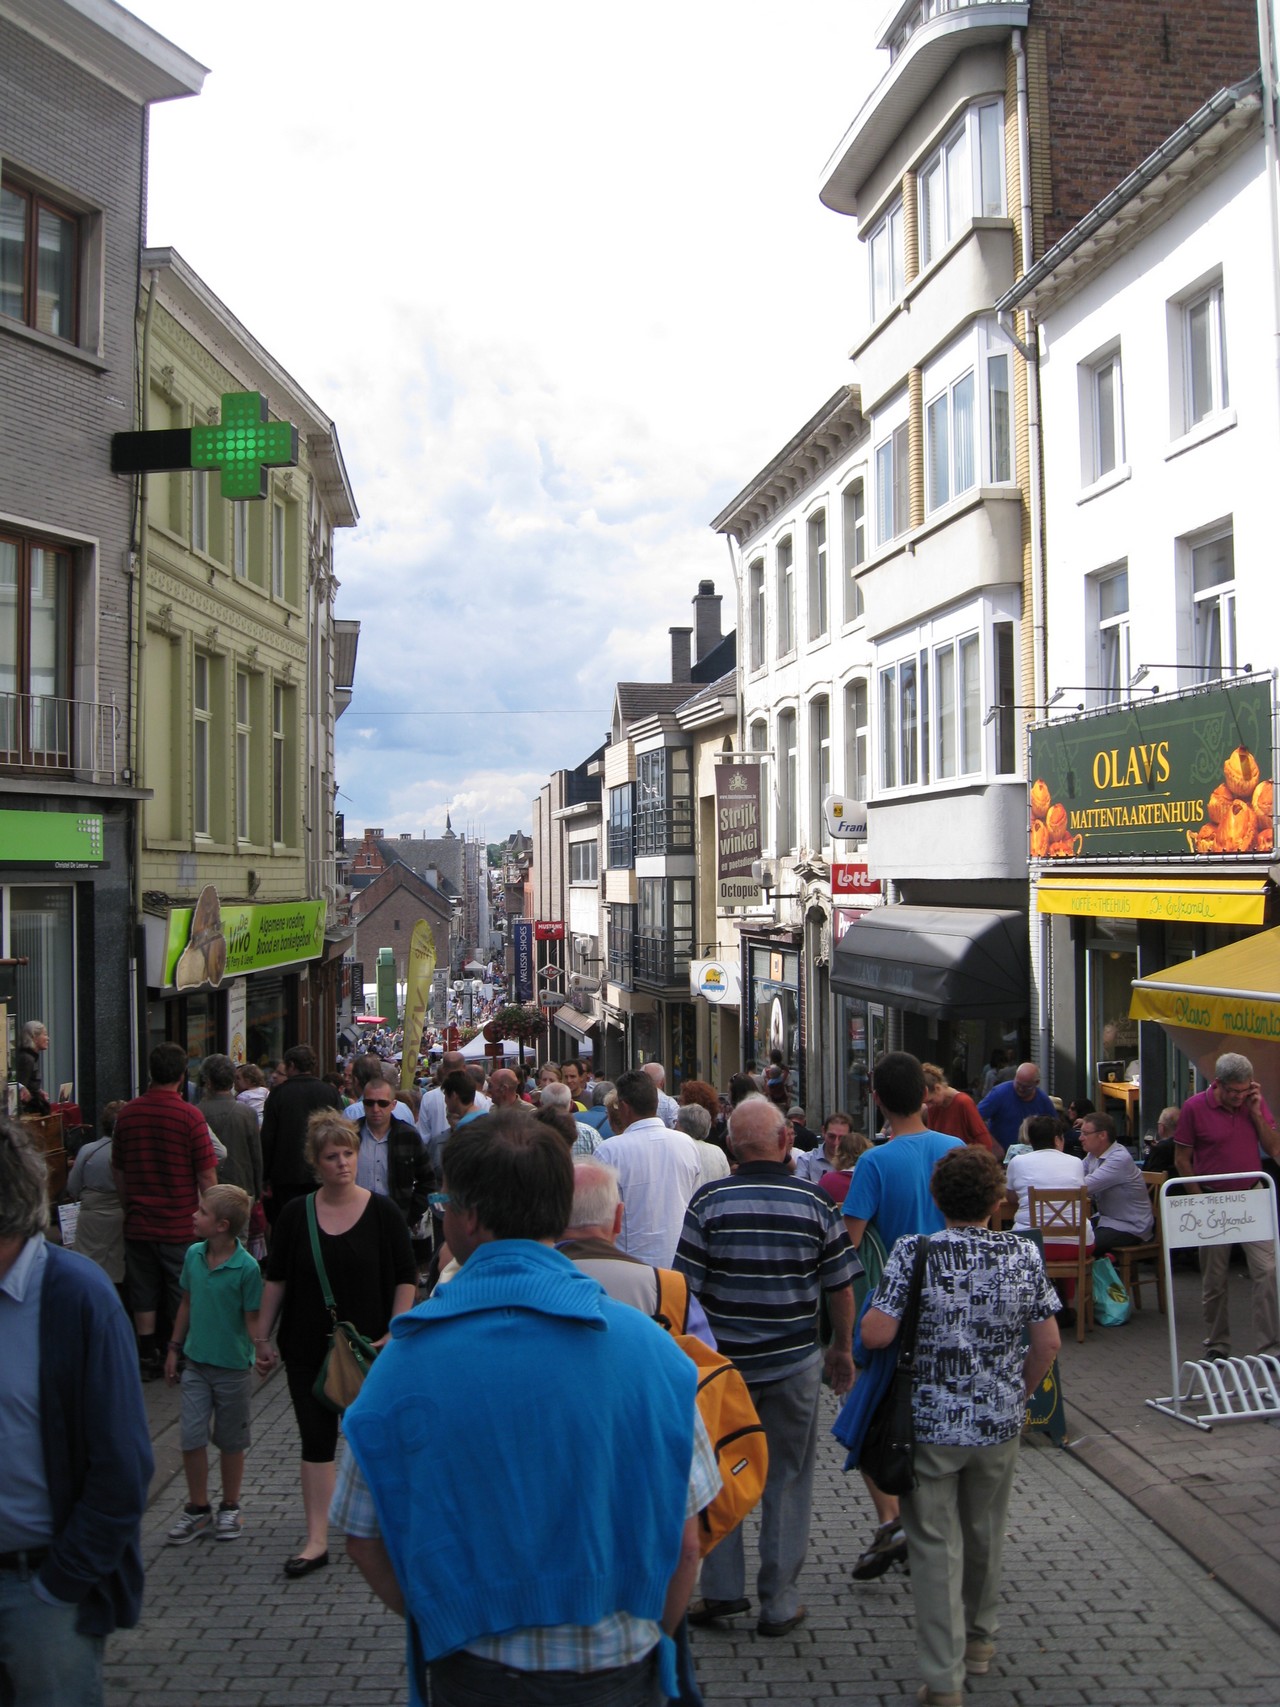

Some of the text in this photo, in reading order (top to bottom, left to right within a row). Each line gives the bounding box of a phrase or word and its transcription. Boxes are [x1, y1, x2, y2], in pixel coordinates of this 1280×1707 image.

[1093, 741, 1170, 789] OLAVS
[720, 801, 757, 832] Strijk
[1070, 800, 1204, 829] MATTENTAARTENHUIS
[720, 829, 758, 856] winkel
[721, 882, 759, 899] Octopus
[837, 869, 877, 887] Lott
[259, 912, 305, 937] Algemene voeding
[256, 936, 273, 955] Brood
[273, 939, 280, 952] en
[520, 926, 528, 952] SHOES
[1175, 997, 1211, 1027] Olavs
[1205, 1194, 1247, 1205] THEEHUIS
[1179, 1210, 1202, 1232] De
